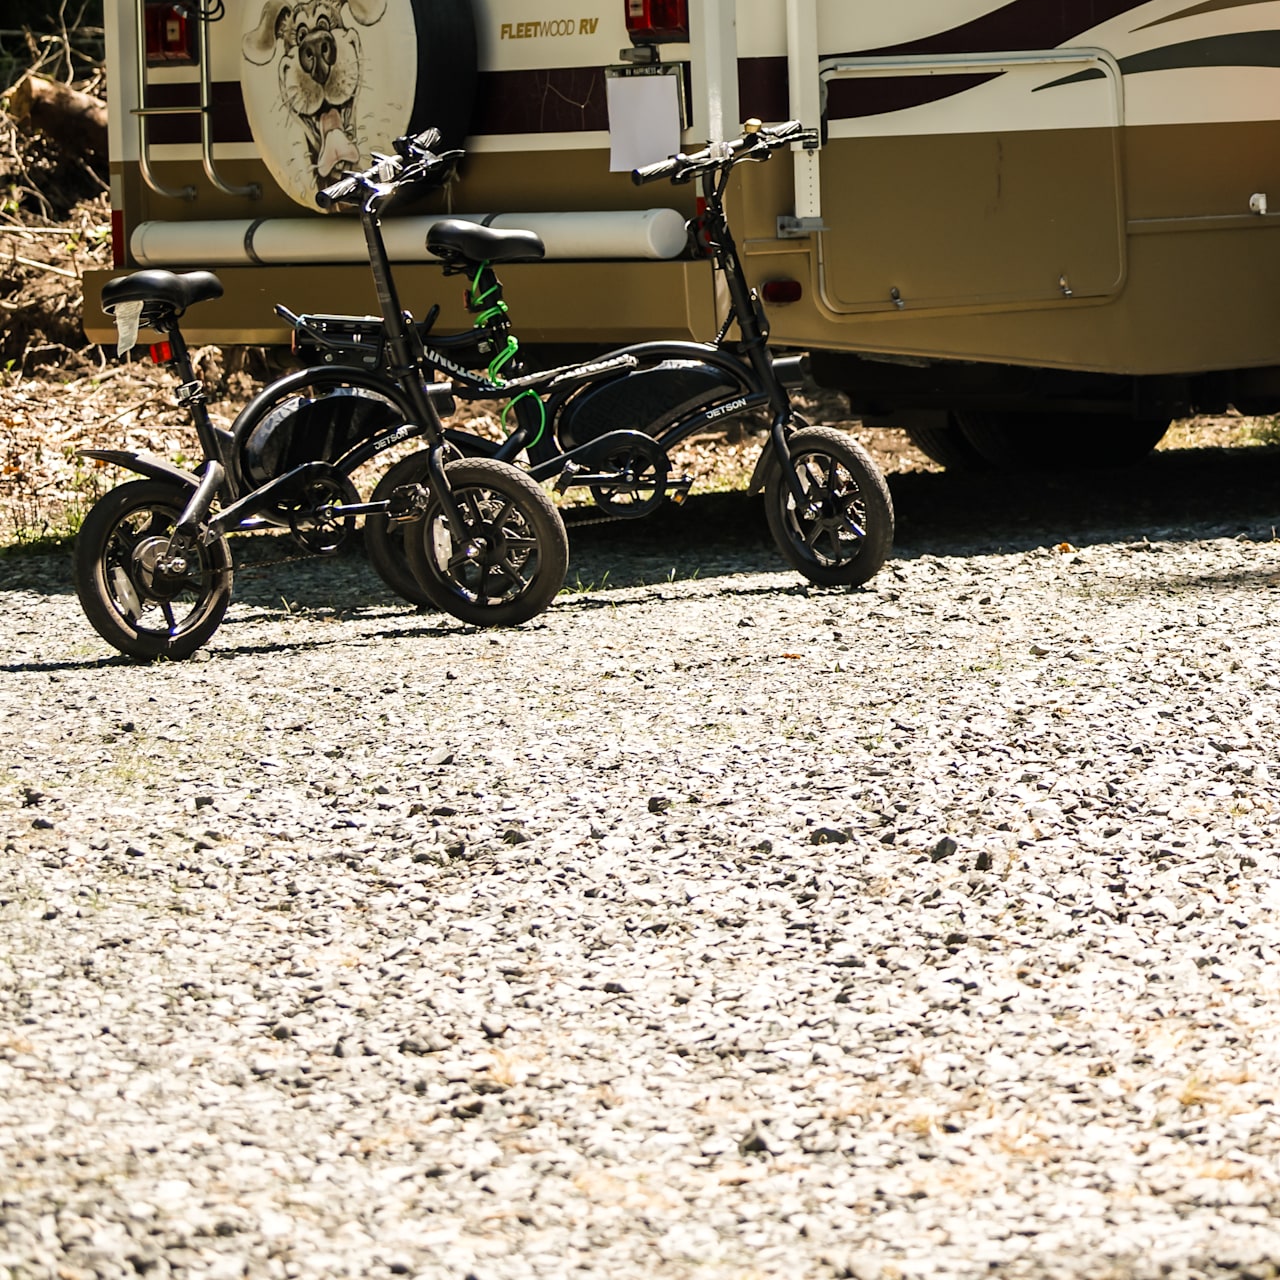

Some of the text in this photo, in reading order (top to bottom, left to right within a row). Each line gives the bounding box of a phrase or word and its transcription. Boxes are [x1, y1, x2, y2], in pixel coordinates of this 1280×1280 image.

[501, 18, 599, 40] FLEETWOOD RV
[705, 398, 747, 419] JETSON
[373, 428, 409, 450] JETSON
